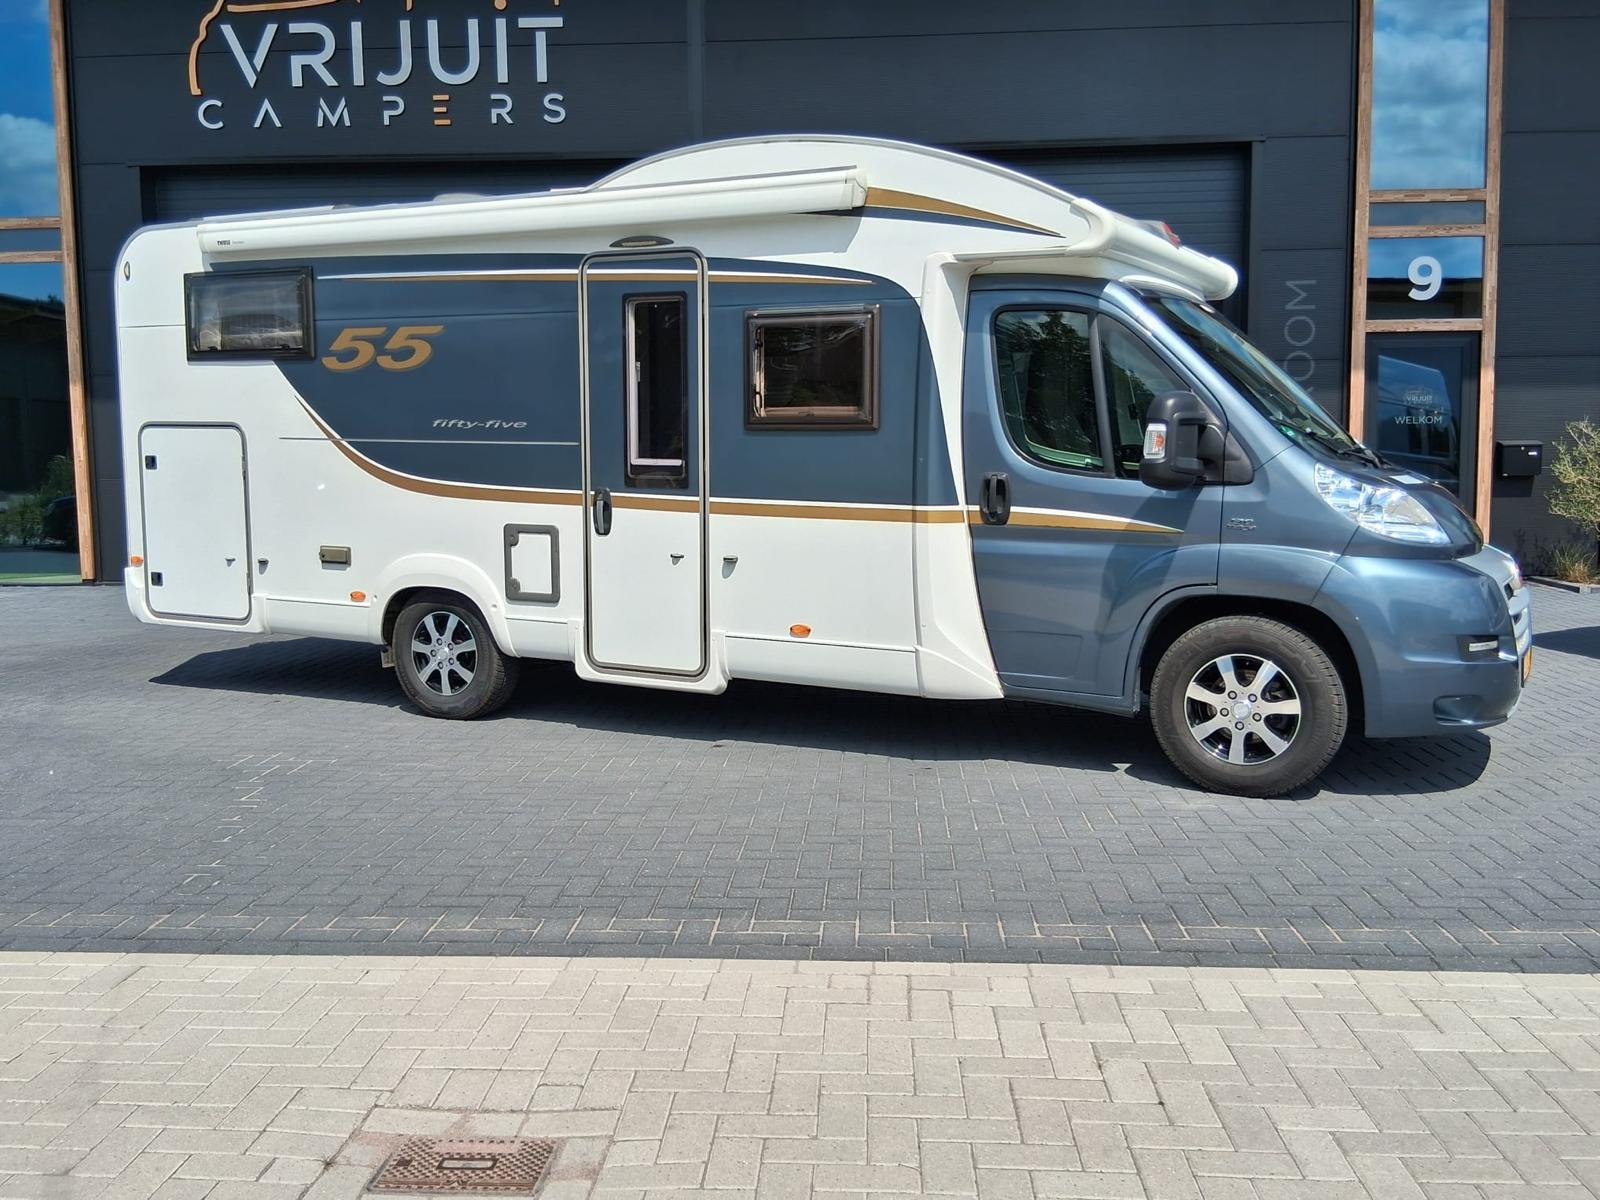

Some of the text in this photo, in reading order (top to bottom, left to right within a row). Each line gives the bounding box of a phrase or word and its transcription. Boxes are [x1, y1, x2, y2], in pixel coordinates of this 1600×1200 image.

[220, 17, 563, 89] VRIJUIT
[198, 93, 566, 129] CAMPERS
[1407, 255, 1443, 301] 9
[321, 325, 447, 372] 55
[1284, 280, 1317, 395] OOM
[432, 418, 528, 430] fifty-five
[1394, 415, 1442, 425] WELKOM
